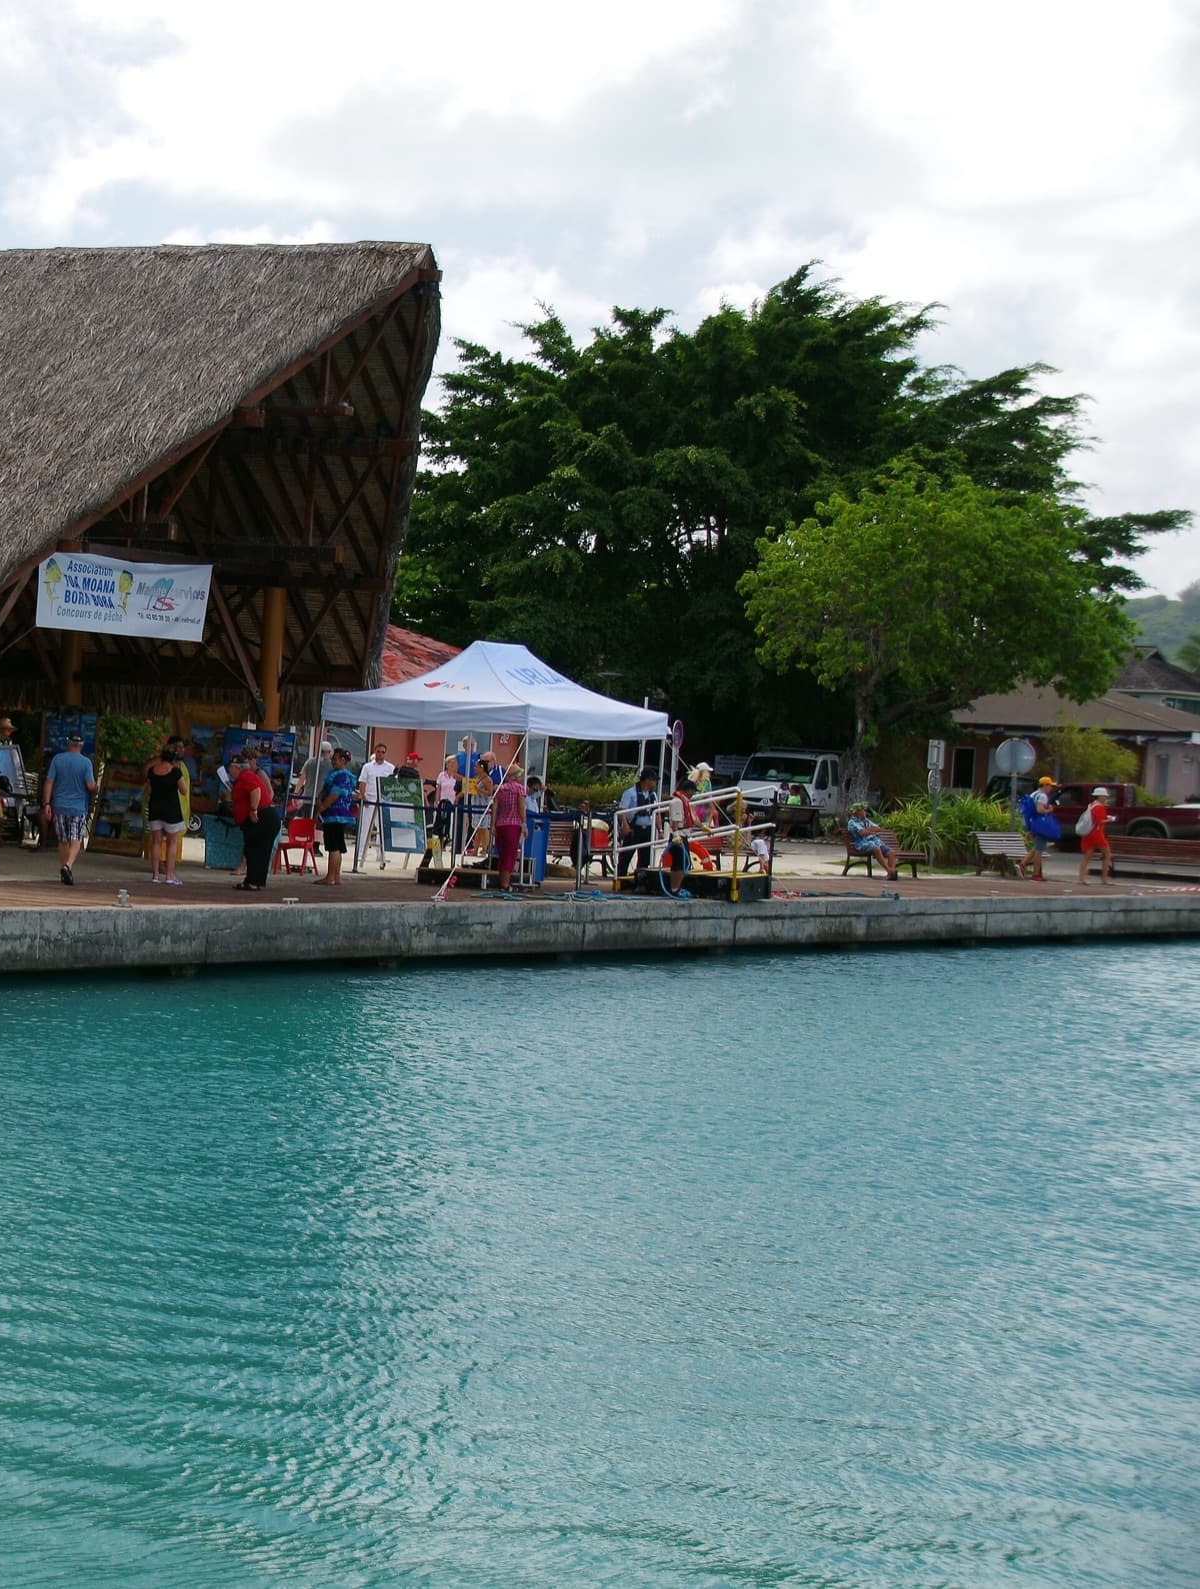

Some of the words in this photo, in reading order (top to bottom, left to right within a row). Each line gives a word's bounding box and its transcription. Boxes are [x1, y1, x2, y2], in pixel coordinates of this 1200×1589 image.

[67, 559, 114, 577] Association
[82, 577, 116, 595] MOANA
[64, 590, 91, 606] BORA
[57, 606, 92, 619] Concours
[94, 609, 103, 620] de
